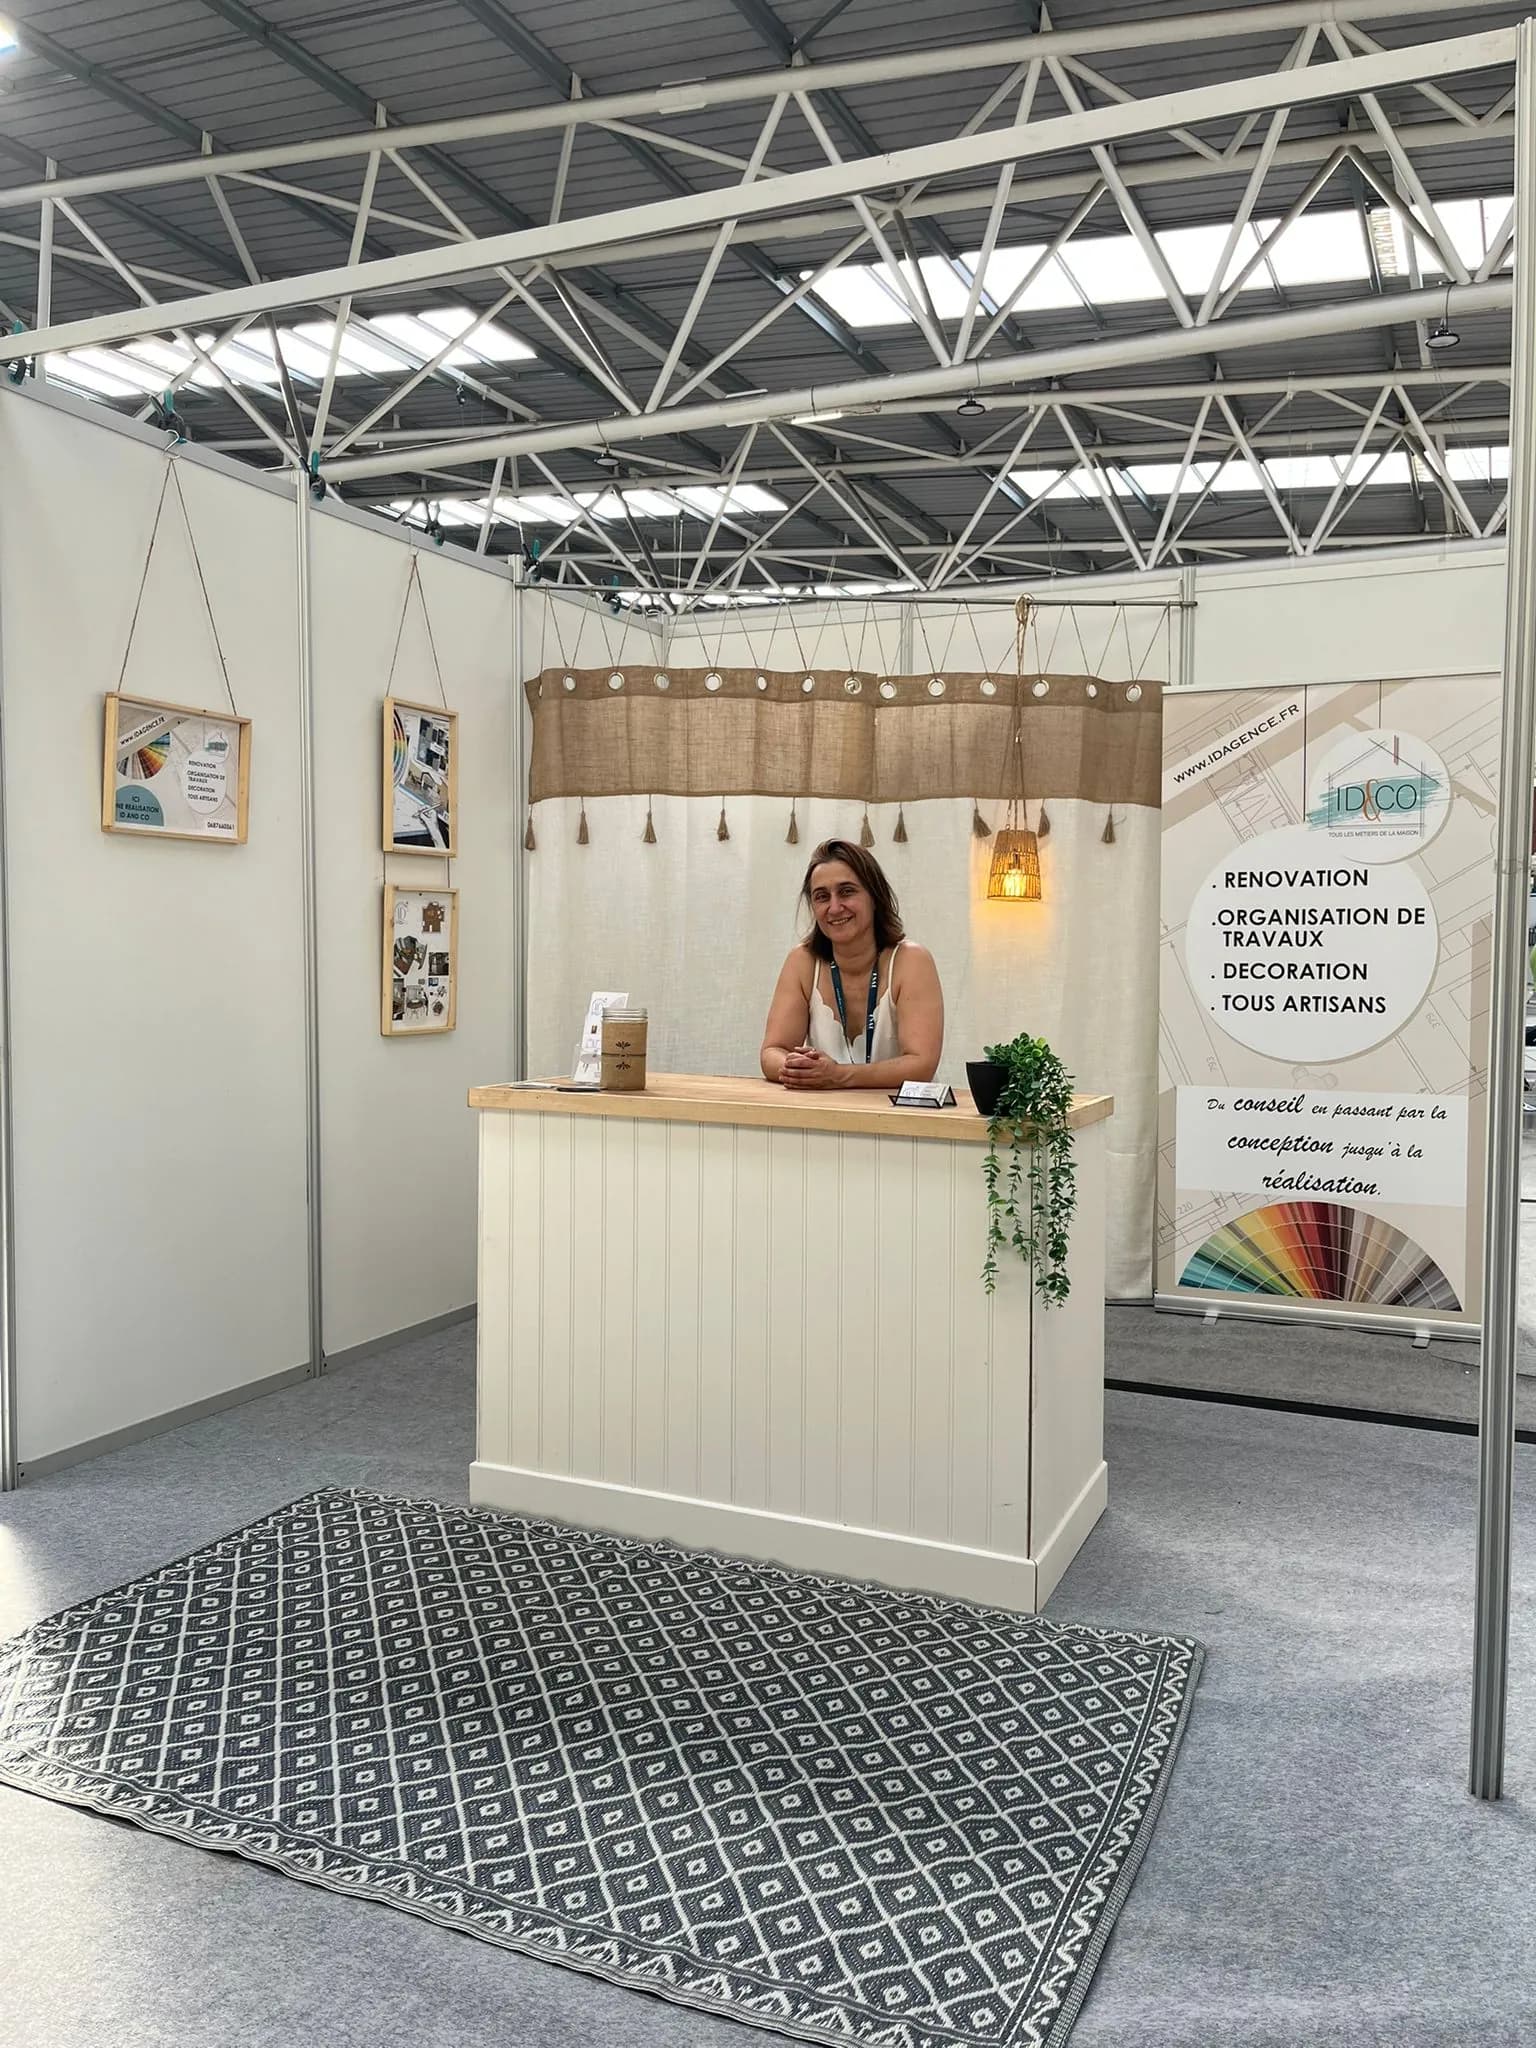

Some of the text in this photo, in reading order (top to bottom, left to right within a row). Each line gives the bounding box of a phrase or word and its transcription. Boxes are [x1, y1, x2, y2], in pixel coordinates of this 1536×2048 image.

[1173, 704, 1300, 783] www.IDAGENCE.FR
[1337, 779, 1417, 822] ID&CO
[1225, 869, 1368, 889] RENOVATION
[1397, 908, 1426, 925] DE
[1223, 931, 1324, 948] TRAVAUX
[1224, 963, 1368, 980] DECORATION
[1222, 995, 1386, 1013] TOUS ARTISANS
[1207, 1094, 1448, 1121] Du conseil en passant par la
[1227, 1135, 1334, 1156] conception
[1407, 1144, 1423, 1158] la
[1262, 1169, 1381, 1196] réalisation.
